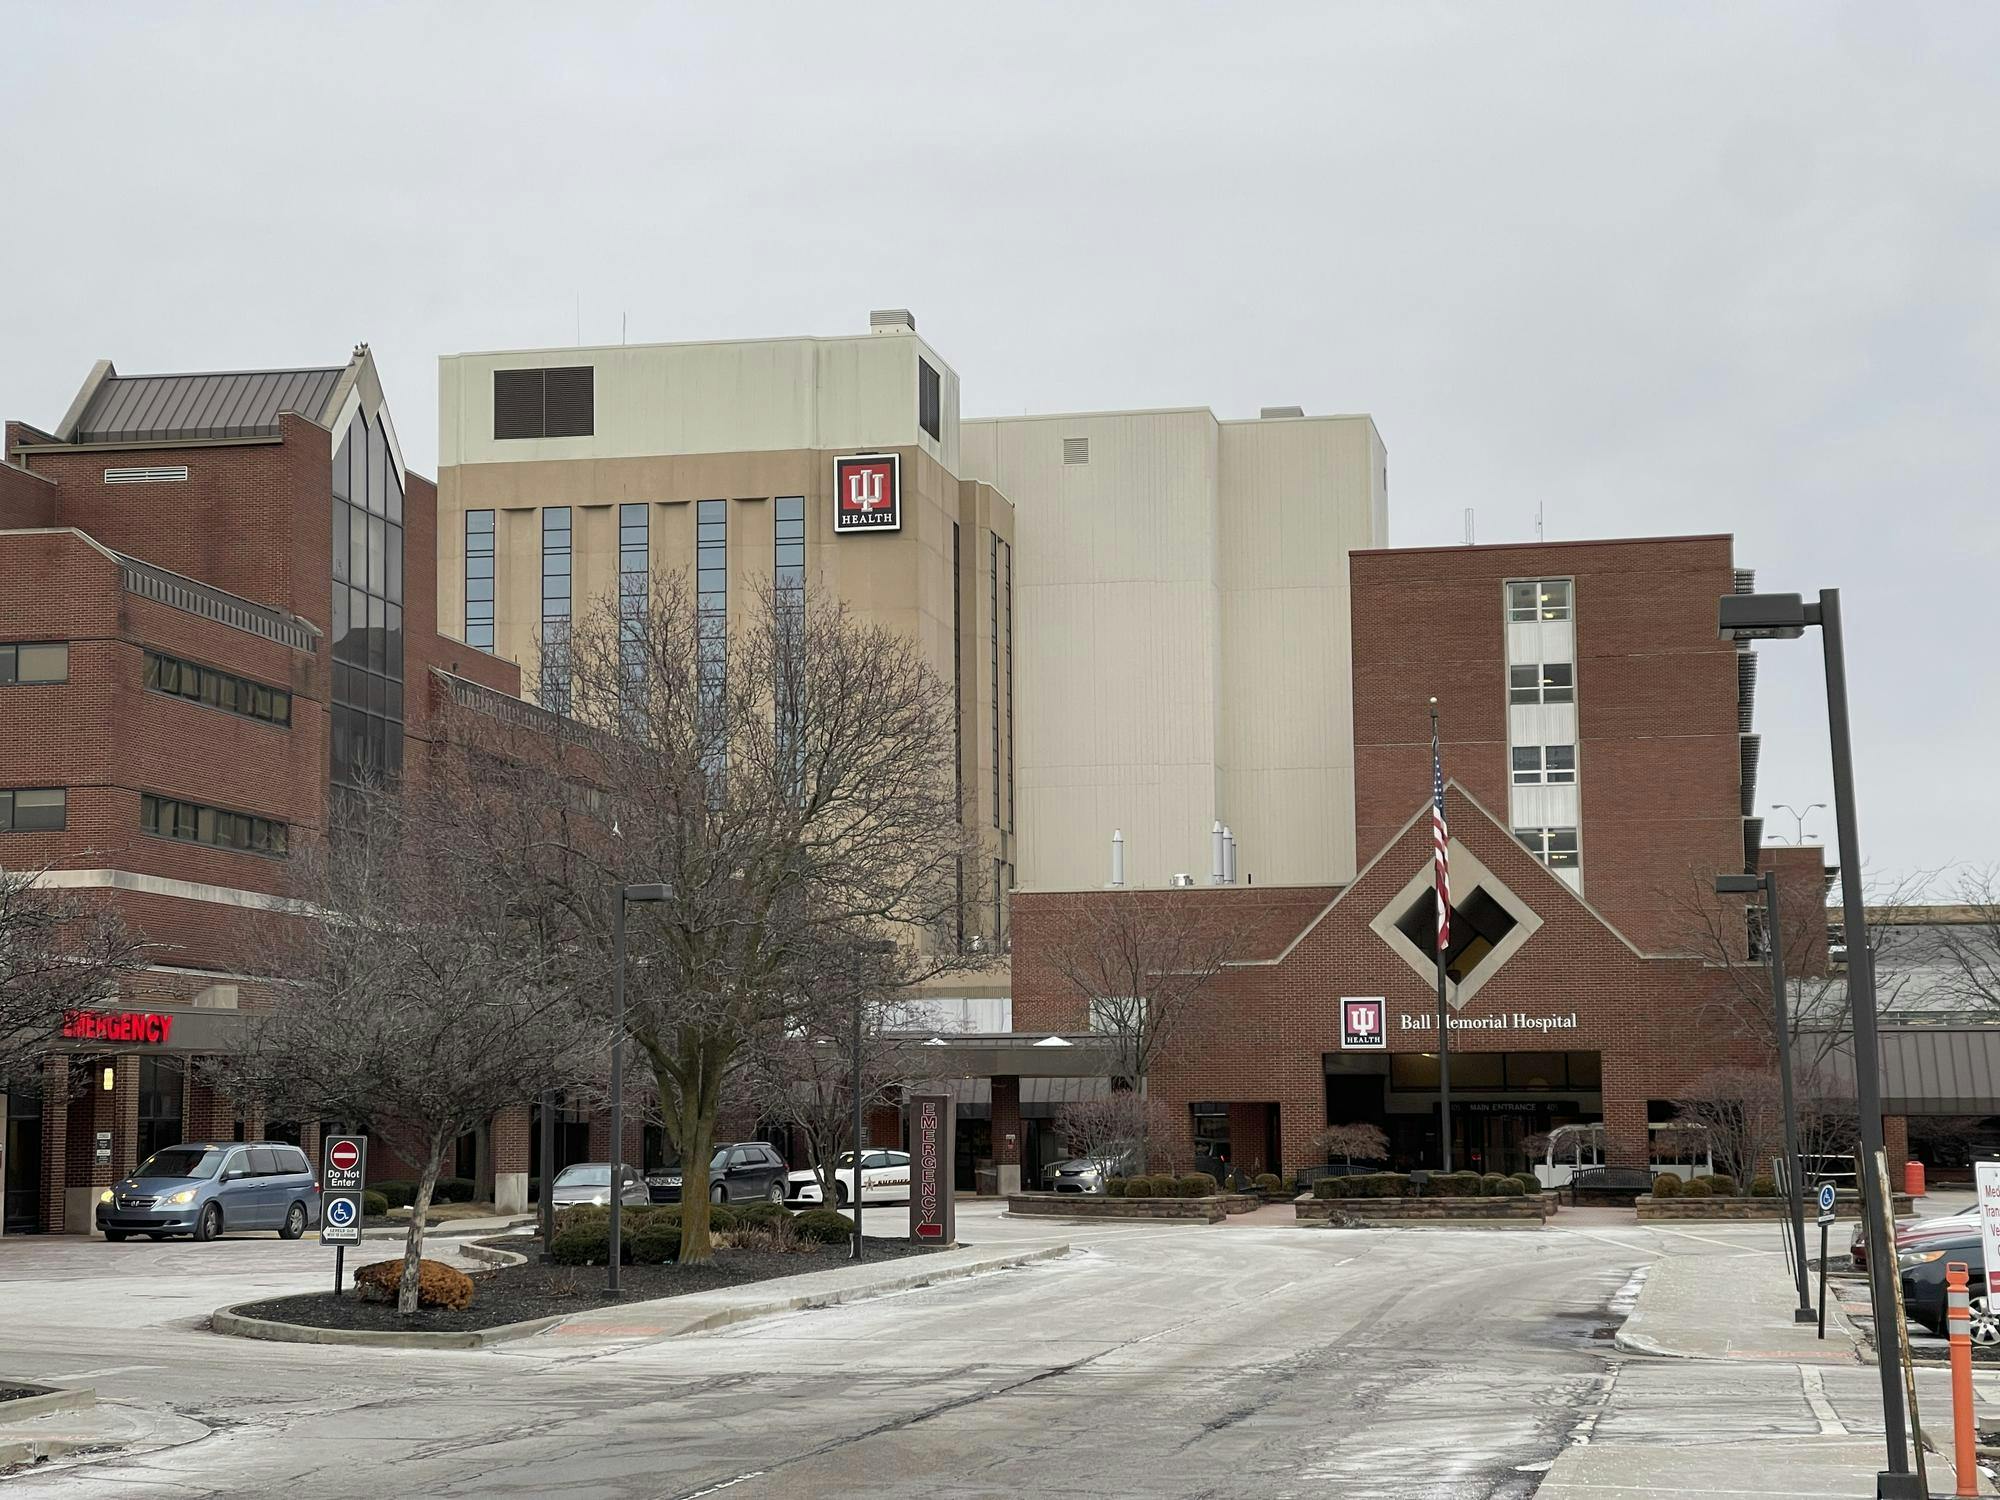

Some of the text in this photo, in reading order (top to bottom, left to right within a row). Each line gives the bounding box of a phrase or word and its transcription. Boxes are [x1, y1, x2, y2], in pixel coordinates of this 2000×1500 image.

[842, 513, 893, 525] HEALTH
[1401, 1014, 1431, 1030] Ball
[1512, 1013, 1577, 1033] Hospital
[1347, 1036, 1381, 1044] HEALTH
[1470, 1103, 1490, 1112] MAIN
[1492, 1103, 1537, 1112] ENTRANCE
[920, 1102, 938, 1223] EMERGENCY
[327, 1169, 360, 1179] Do Not
[331, 1179, 356, 1187] Enter
